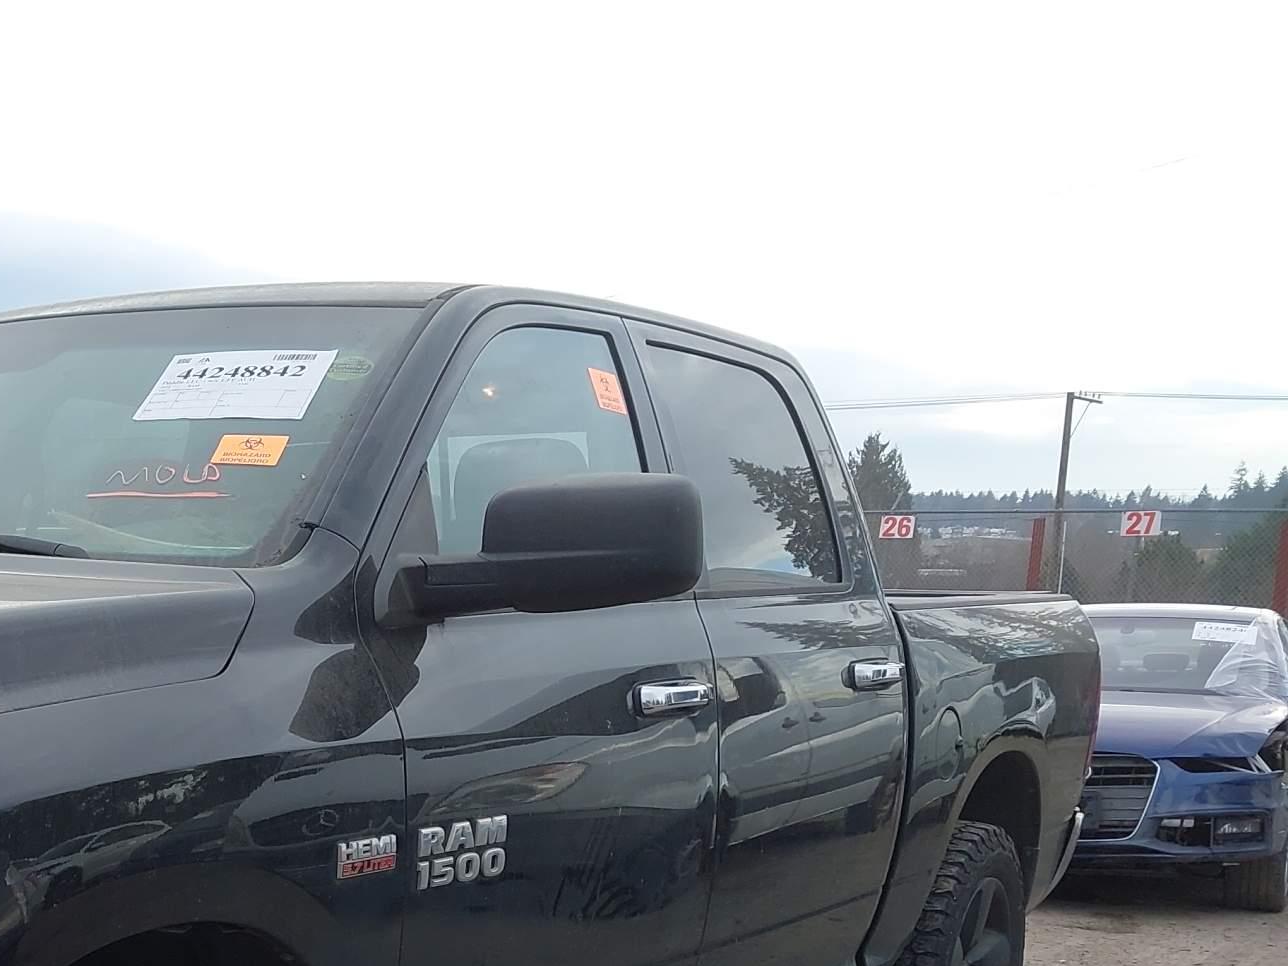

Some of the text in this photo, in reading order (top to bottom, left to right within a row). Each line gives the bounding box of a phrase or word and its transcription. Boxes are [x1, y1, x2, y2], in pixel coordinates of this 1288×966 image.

[177, 365, 307, 380] 44248842
[882, 516, 912, 538] 26
[1126, 511, 1157, 535] 27
[337, 834, 397, 862] HEMI
[417, 814, 508, 858] RAM
[343, 860, 363, 876] 5.7
[416, 847, 506, 890] 1500
